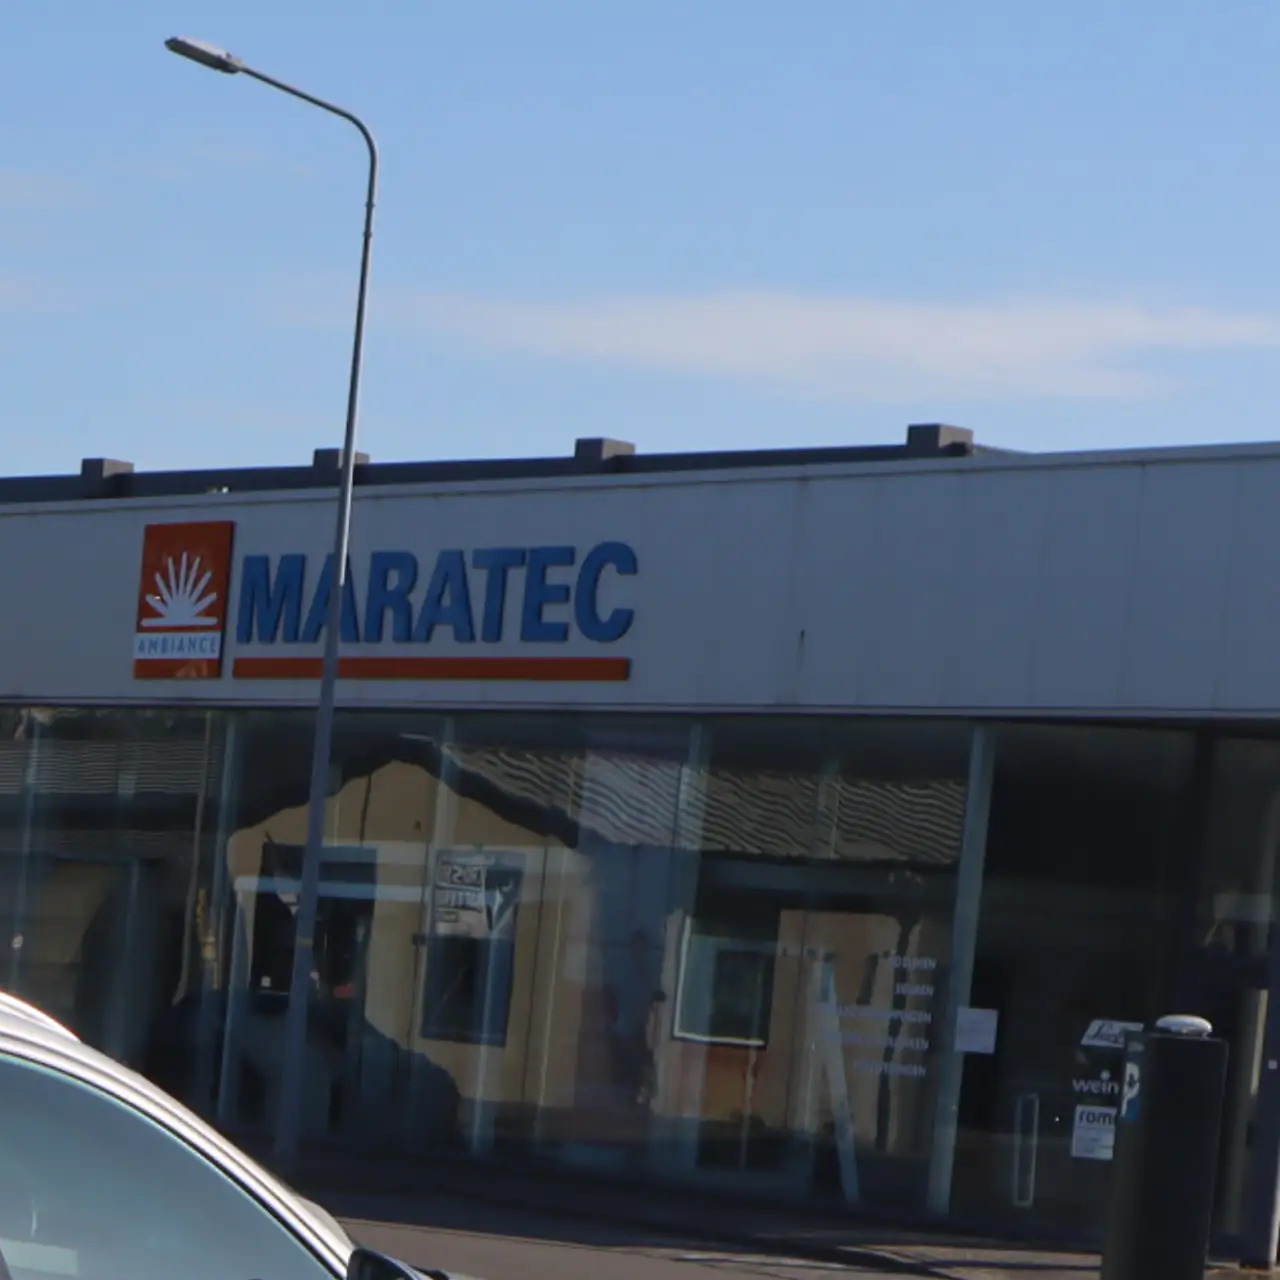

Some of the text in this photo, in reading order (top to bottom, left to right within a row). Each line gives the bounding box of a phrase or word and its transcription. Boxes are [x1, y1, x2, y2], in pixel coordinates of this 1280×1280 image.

[236, 541, 639, 644] MARATEC
[137, 635, 217, 655] AMBIANCE
[1078, 1109, 1116, 1125] rom
